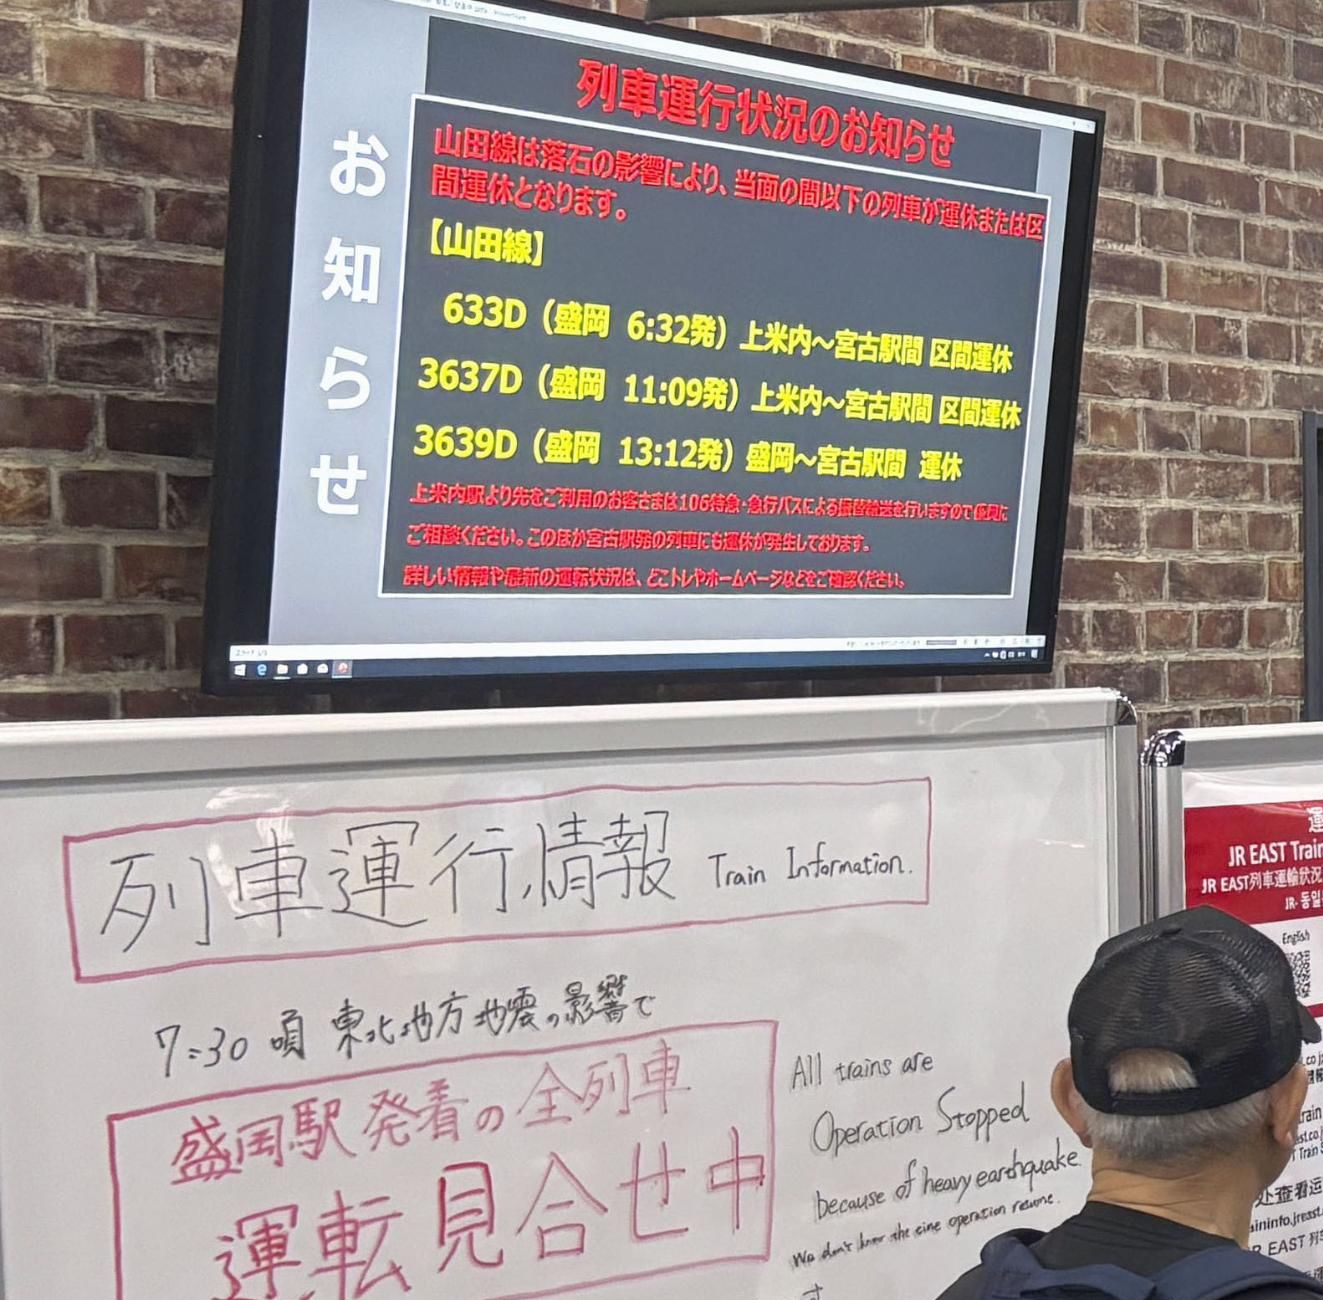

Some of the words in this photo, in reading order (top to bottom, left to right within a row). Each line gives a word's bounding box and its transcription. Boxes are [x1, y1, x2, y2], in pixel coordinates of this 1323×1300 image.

[576, 58, 955, 168] 列車運行状況のお知らせ
[431, 165, 628, 221] 間運休となります。
[430, 218, 544, 266] 【山田線】
[310, 130, 389, 515] お知らせ
[443, 292, 527, 329] 633D
[929, 338, 1014, 374] 区間運休
[417, 357, 523, 394] 3637D
[938, 395, 1022, 430] 区間運休
[413, 424, 518, 460] 3639D
[918, 450, 963, 482] 運休
[100, 811, 676, 953] 列車運行情報
[708, 853, 767, 888] Train
[1228, 846, 1247, 868] JR
[1249, 842, 1287, 865] EAST
[1201, 878, 1217, 894] JR
[1282, 929, 1311, 946] English
[791, 1052, 822, 1090] All
[835, 1058, 893, 1083] trains
[901, 1052, 935, 1074] are
[812, 1110, 924, 1157] Operation
[936, 1080, 1031, 1142] Stopped
[814, 1189, 887, 1222] because
[896, 1158, 918, 1200] of
[922, 1165, 973, 1202] heavy
[977, 1136, 1080, 1192] earthquake
[948, 1203, 1006, 1236] operation
[1268, 1234, 1306, 1256] EAST
